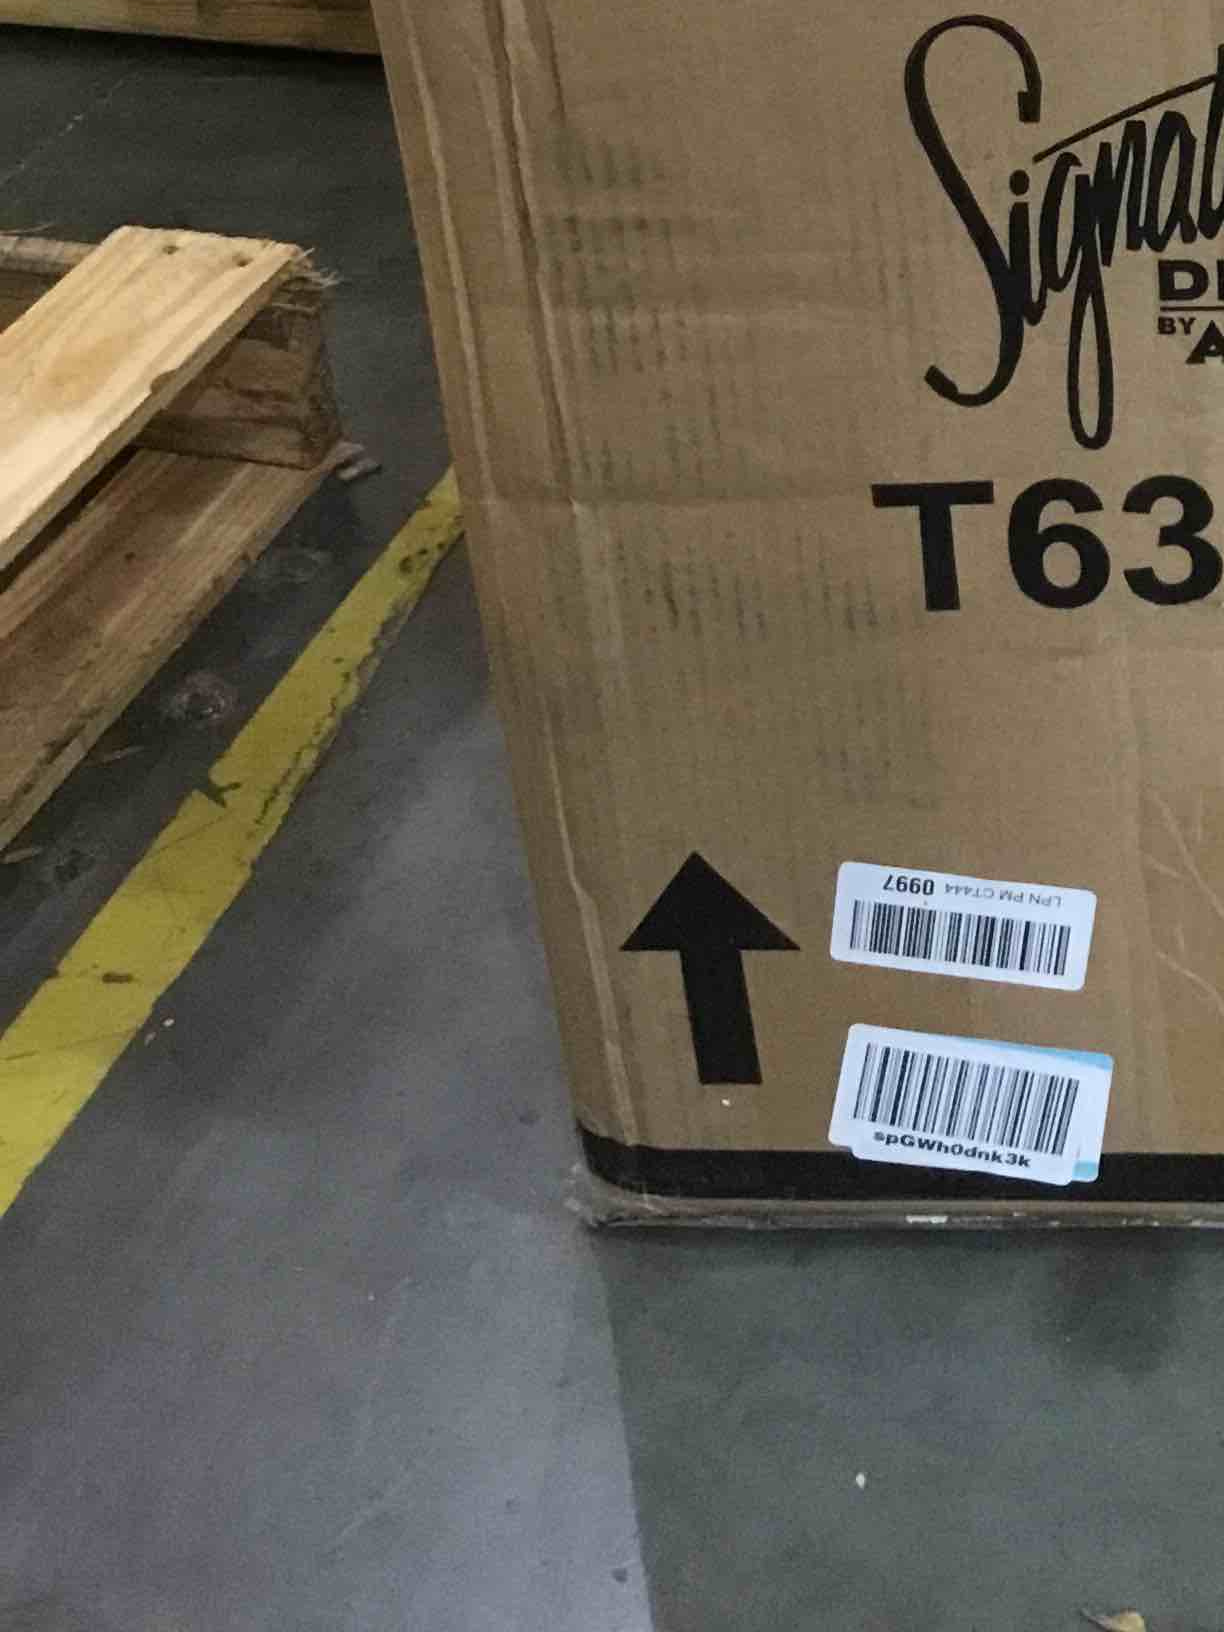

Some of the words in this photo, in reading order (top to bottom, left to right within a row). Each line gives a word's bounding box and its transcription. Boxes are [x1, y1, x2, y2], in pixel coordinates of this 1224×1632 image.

[1157, 316, 1196, 335] BY
[882, 874, 935, 896] 0997
[999, 888, 1024, 904] PM
[1029, 892, 1062, 908] LPN
